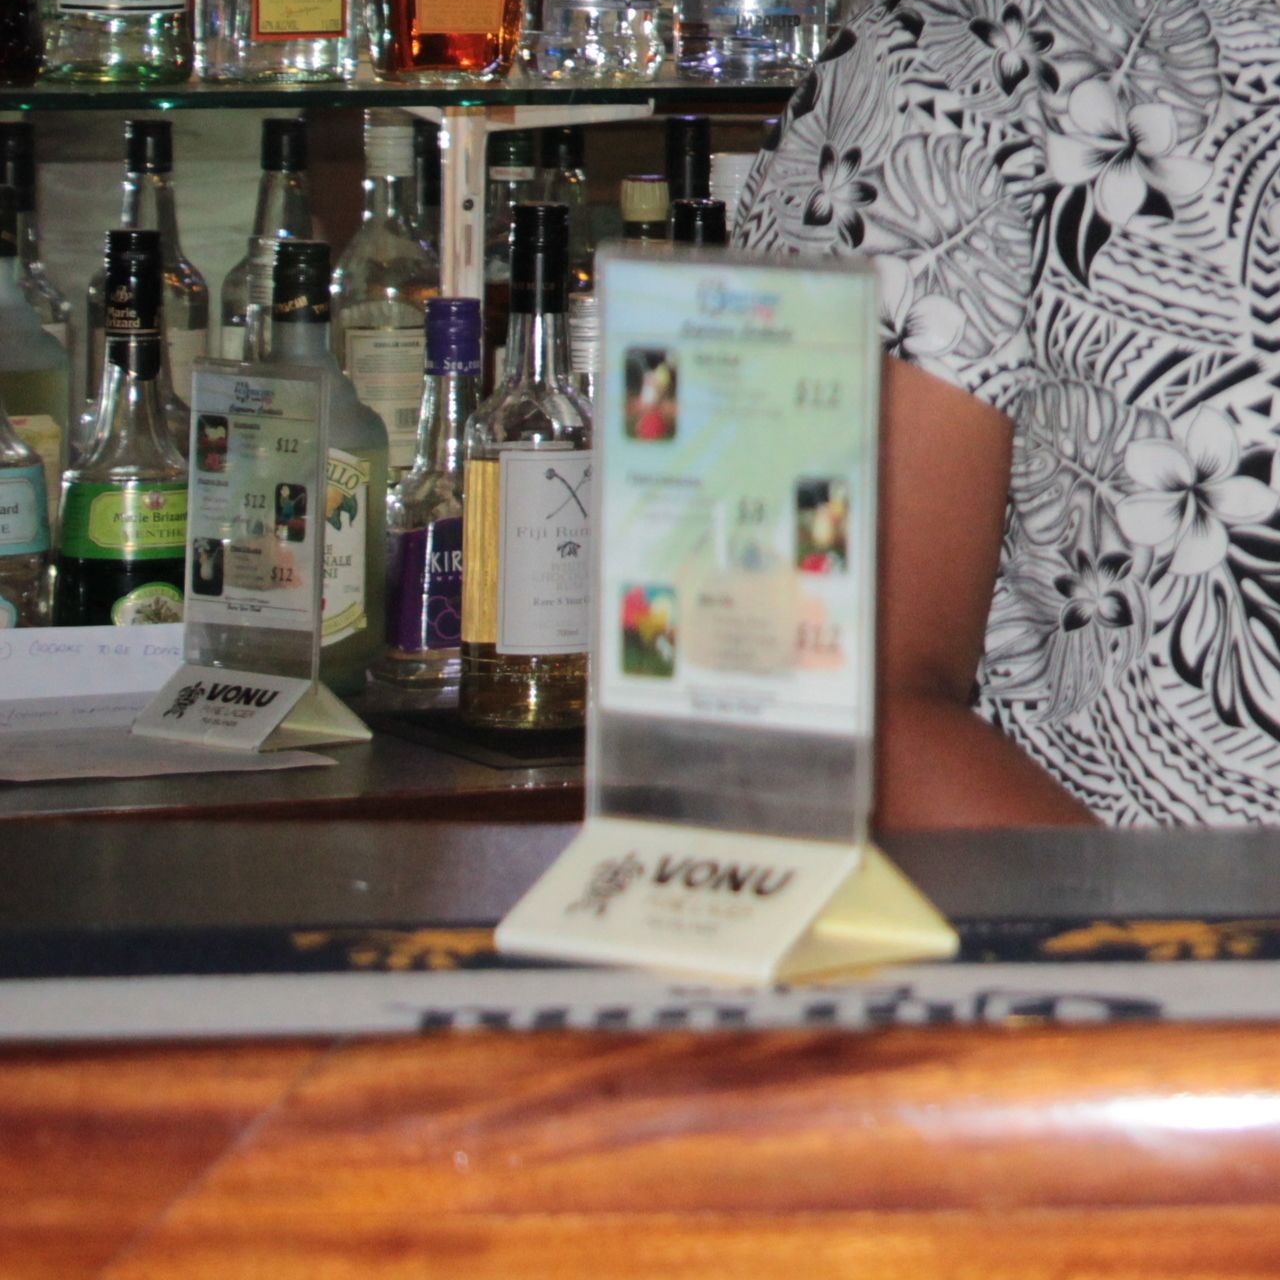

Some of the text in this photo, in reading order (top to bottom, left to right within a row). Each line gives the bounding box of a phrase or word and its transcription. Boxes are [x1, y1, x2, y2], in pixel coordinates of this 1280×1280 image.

[276, 437, 299, 454] $12
[243, 493, 266, 509] $12
[516, 526, 547, 541] Fiji
[270, 566, 294, 582] $12
[206, 682, 280, 708] VONU
[653, 853, 797, 899] VONU
